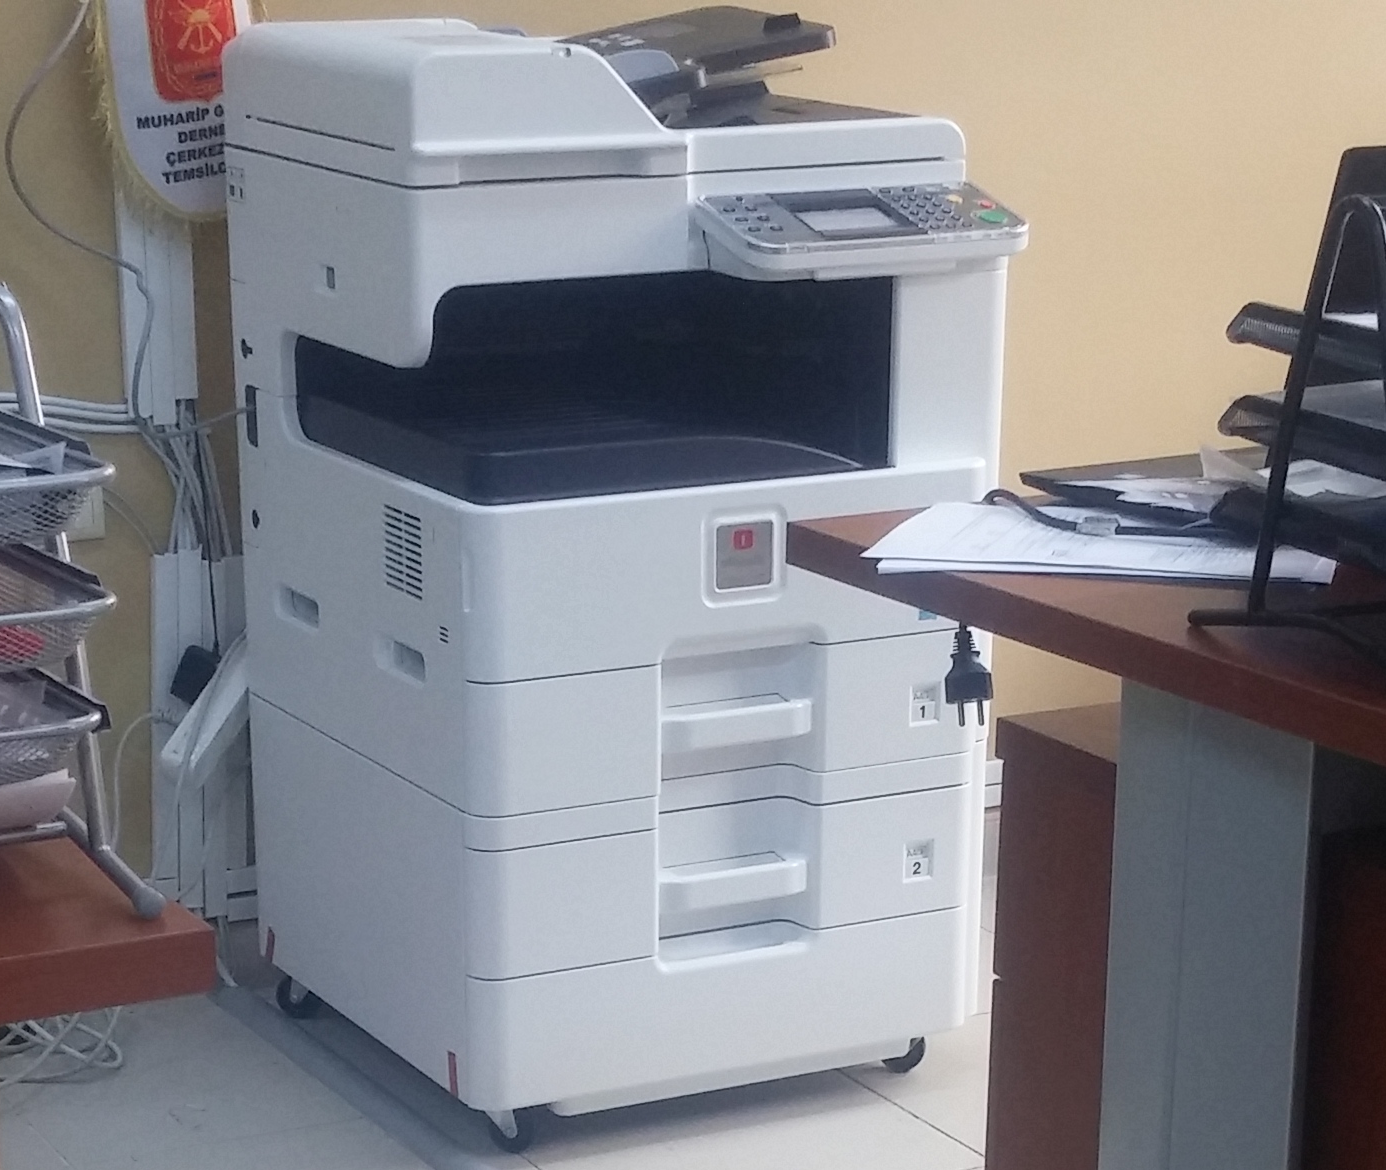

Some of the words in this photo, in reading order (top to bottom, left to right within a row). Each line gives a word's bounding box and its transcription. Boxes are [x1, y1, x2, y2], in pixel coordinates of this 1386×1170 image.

[136, 106, 210, 130] MUHARİP
[165, 142, 225, 167] ÇERKEZ
[919, 705, 926, 719] 1
[912, 861, 922, 876] 2
